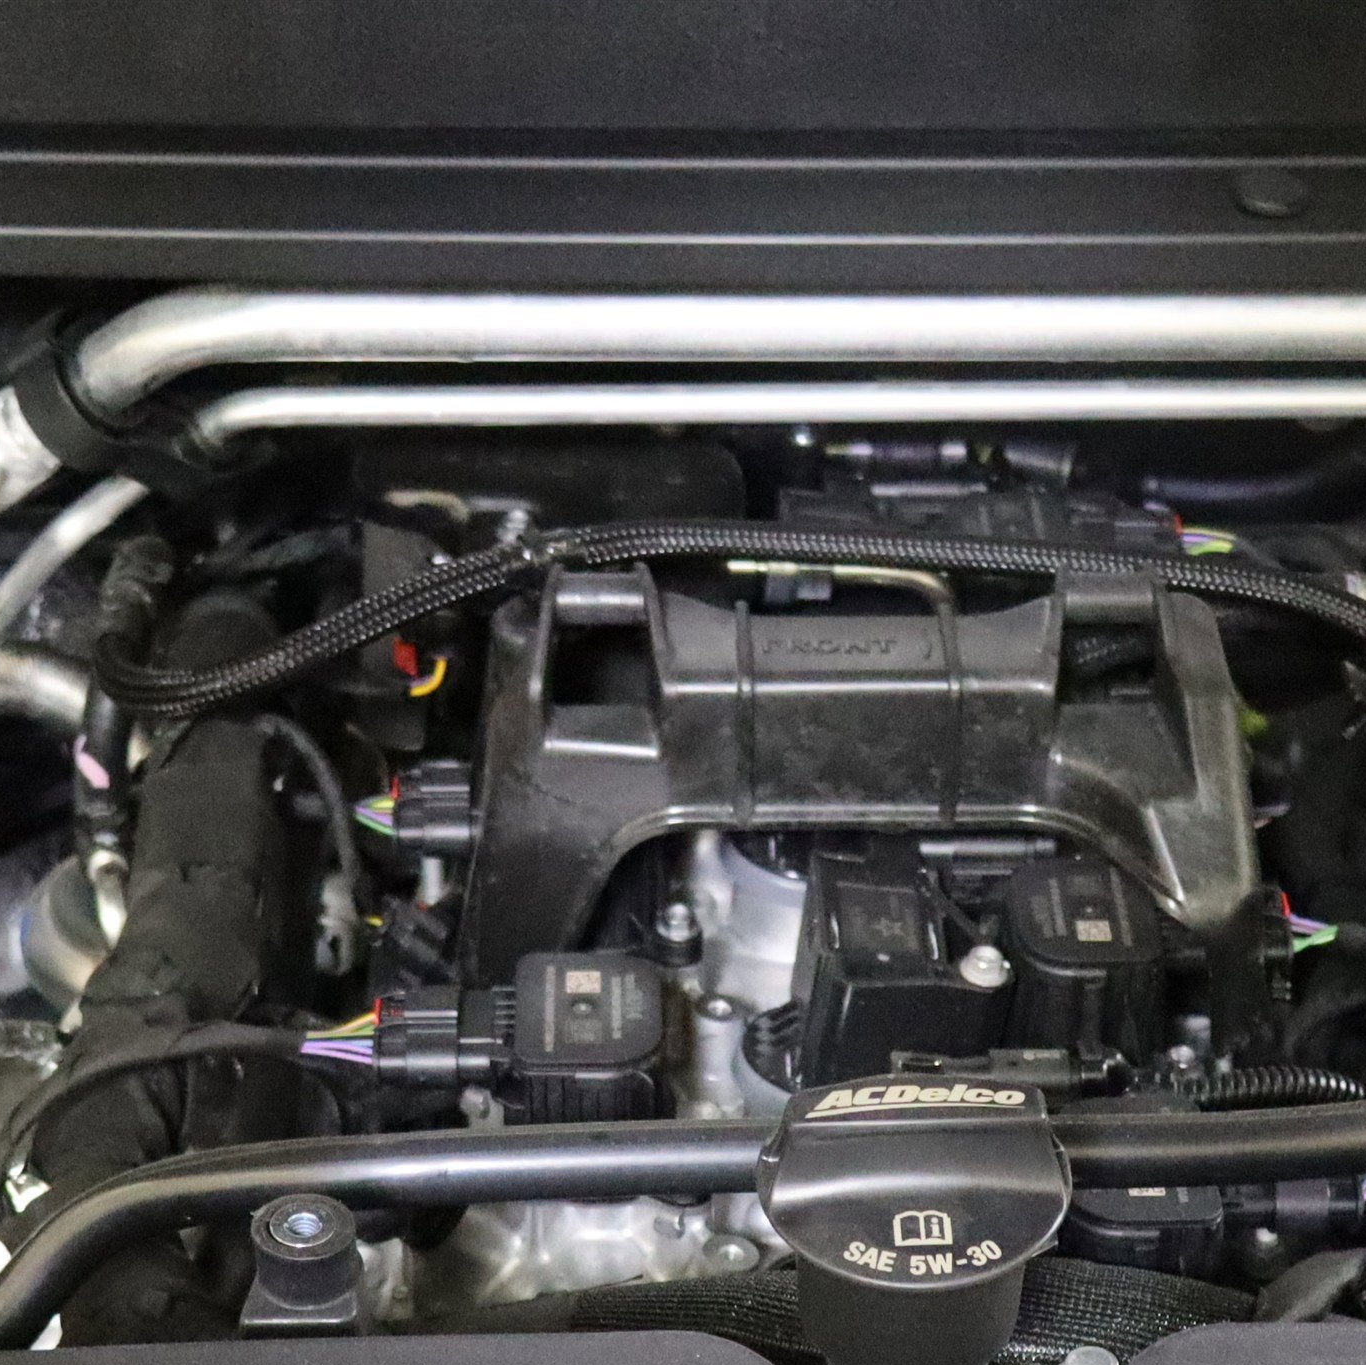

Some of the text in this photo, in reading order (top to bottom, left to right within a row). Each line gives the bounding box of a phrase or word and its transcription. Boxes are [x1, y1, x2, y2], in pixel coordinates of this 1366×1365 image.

[761, 637, 898, 656] FRONT
[809, 1084, 1026, 1114] ACDelco
[843, 1240, 1003, 1276] SAE 5W-30
